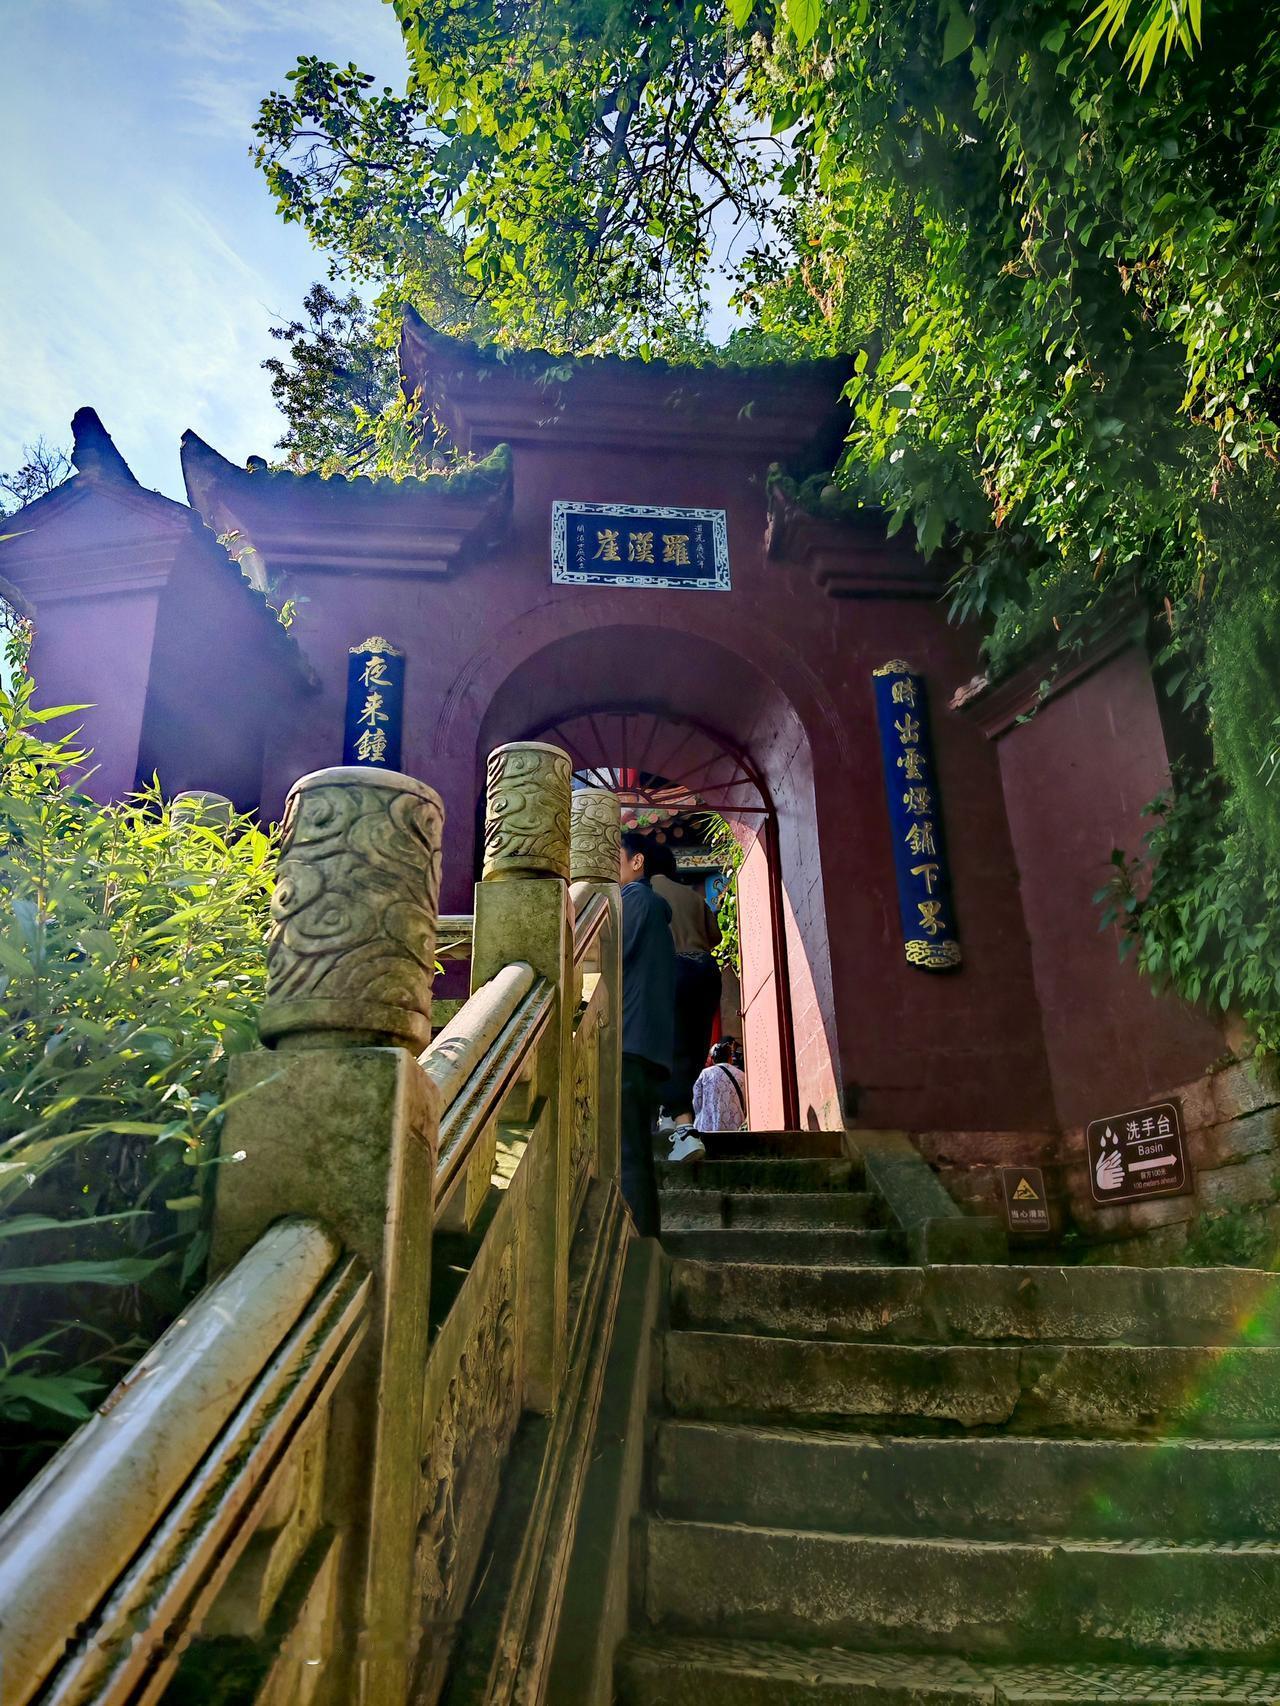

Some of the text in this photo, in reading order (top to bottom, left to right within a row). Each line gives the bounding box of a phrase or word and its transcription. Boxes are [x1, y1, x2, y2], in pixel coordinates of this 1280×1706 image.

[592, 529, 691, 566] 羅漢崖
[1126, 1114, 1170, 1140] 洗手台
[1138, 1143, 1164, 1156] Basin
